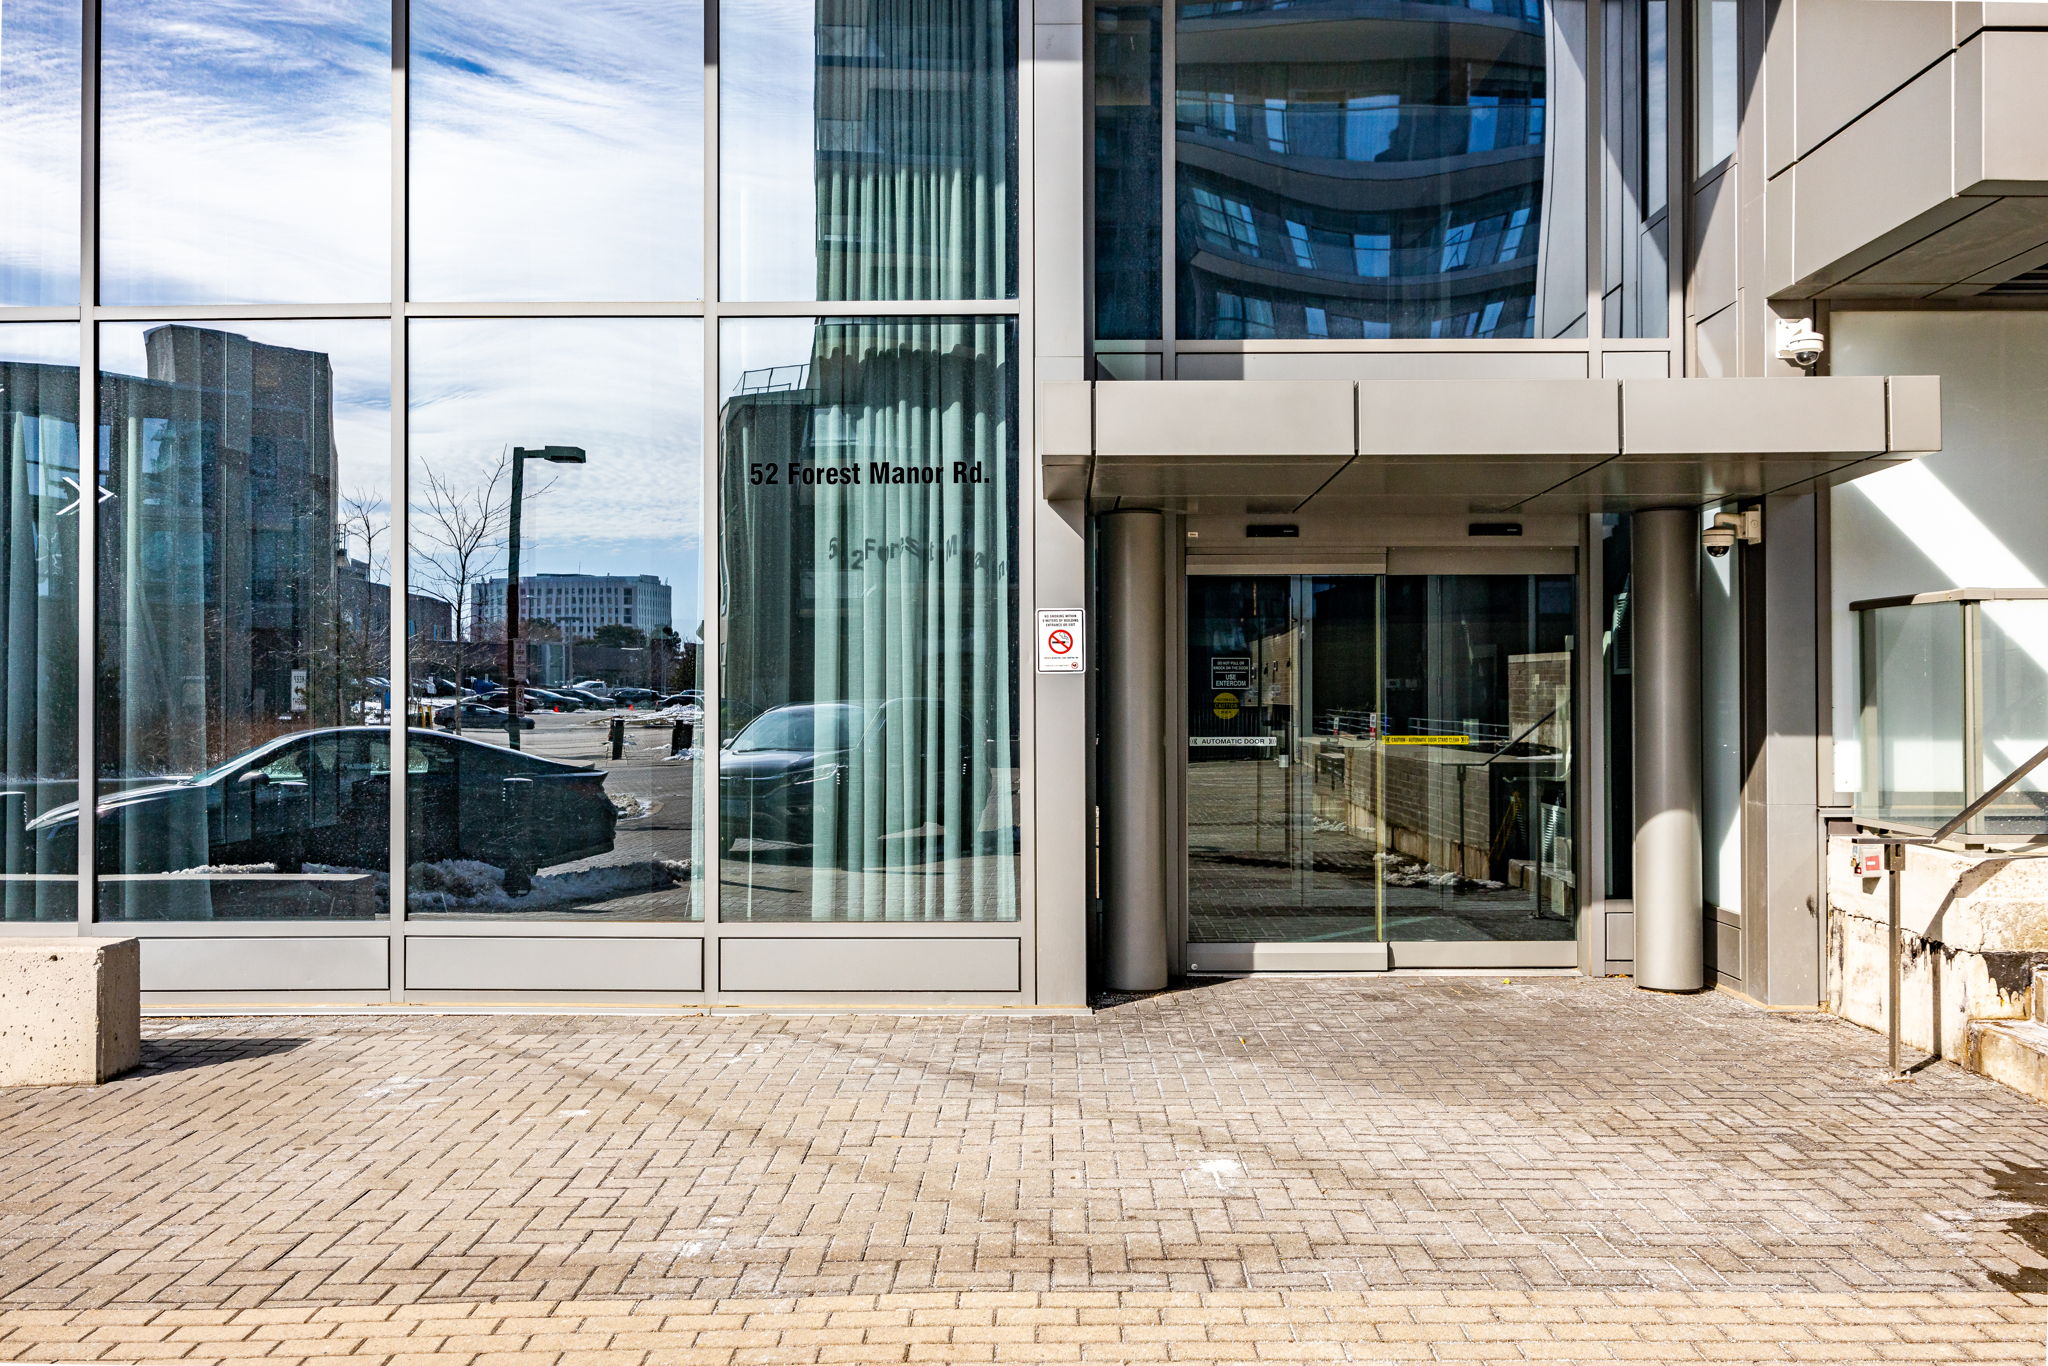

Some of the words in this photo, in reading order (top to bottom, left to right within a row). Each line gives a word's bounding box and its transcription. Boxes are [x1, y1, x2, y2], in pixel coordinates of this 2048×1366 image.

[750, 463, 778, 485] 52
[788, 463, 860, 485] Forest
[869, 462, 944, 484] Manor
[953, 461, 990, 484] Rd.
